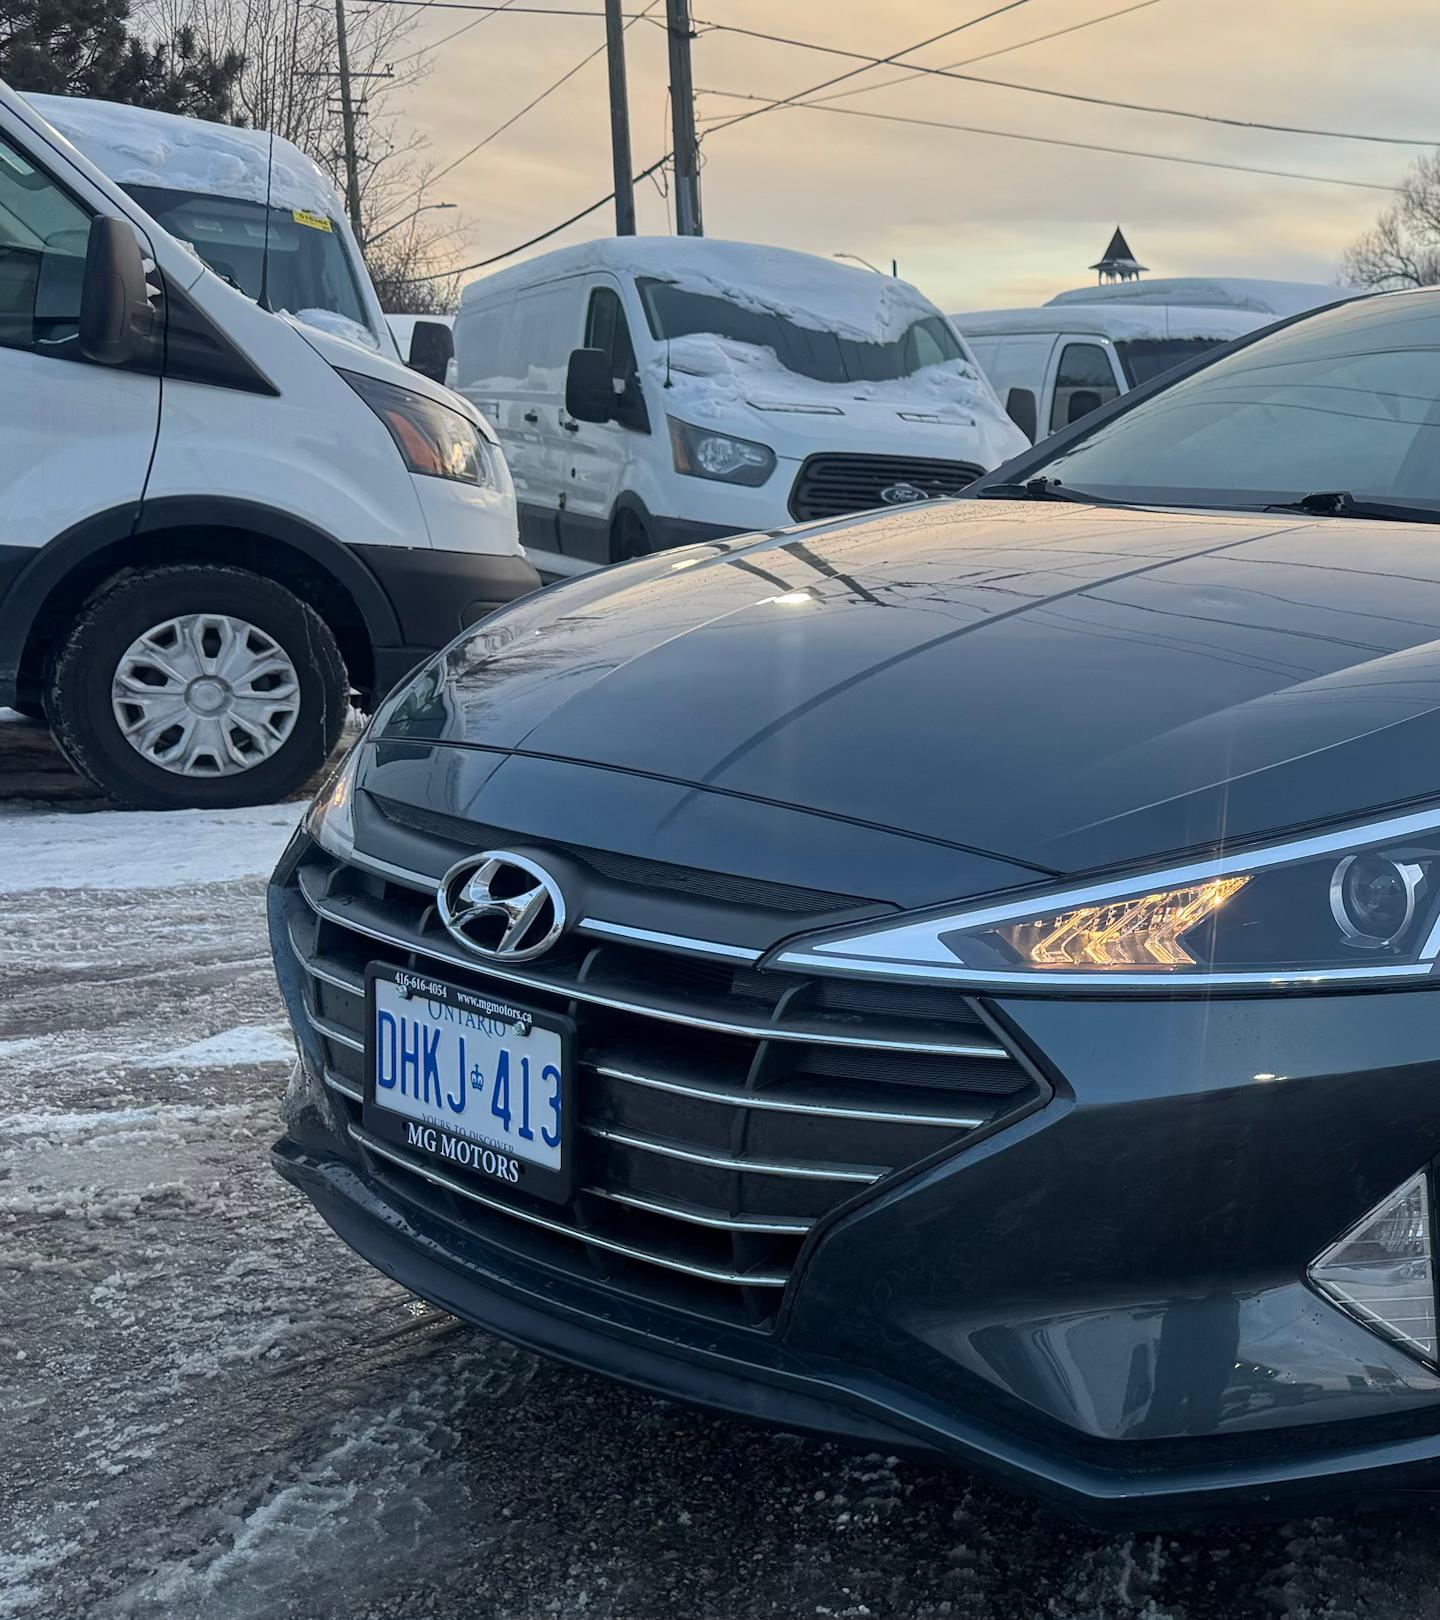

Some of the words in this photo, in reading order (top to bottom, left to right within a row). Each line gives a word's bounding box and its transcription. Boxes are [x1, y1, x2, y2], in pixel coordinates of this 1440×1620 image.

[394, 971, 448, 998] 416-616-4054
[456, 991, 533, 1024] www.mgmotors.ca
[377, 1009, 467, 1114] DHKJ
[491, 1048, 562, 1148] 413
[407, 1121, 437, 1153] MG
[440, 1133, 519, 1183] MOTORS
